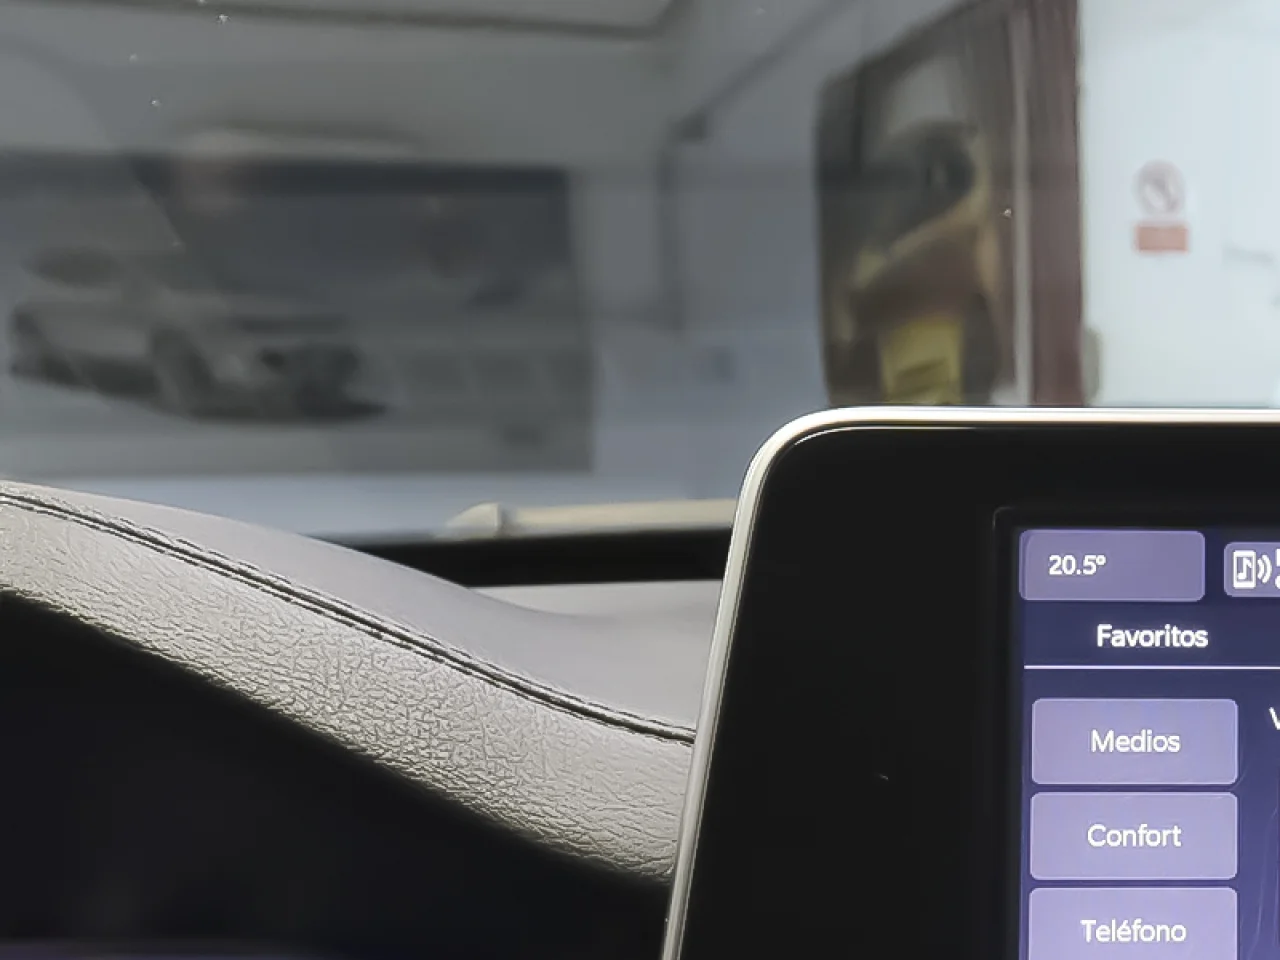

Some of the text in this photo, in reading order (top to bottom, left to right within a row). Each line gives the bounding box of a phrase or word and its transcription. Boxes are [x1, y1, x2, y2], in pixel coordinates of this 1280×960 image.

[1097, 624, 1209, 648] Favoritos
[1090, 730, 1181, 753] Medios
[1087, 824, 1182, 847] Confort
[1081, 918, 1187, 943] Teléfono
